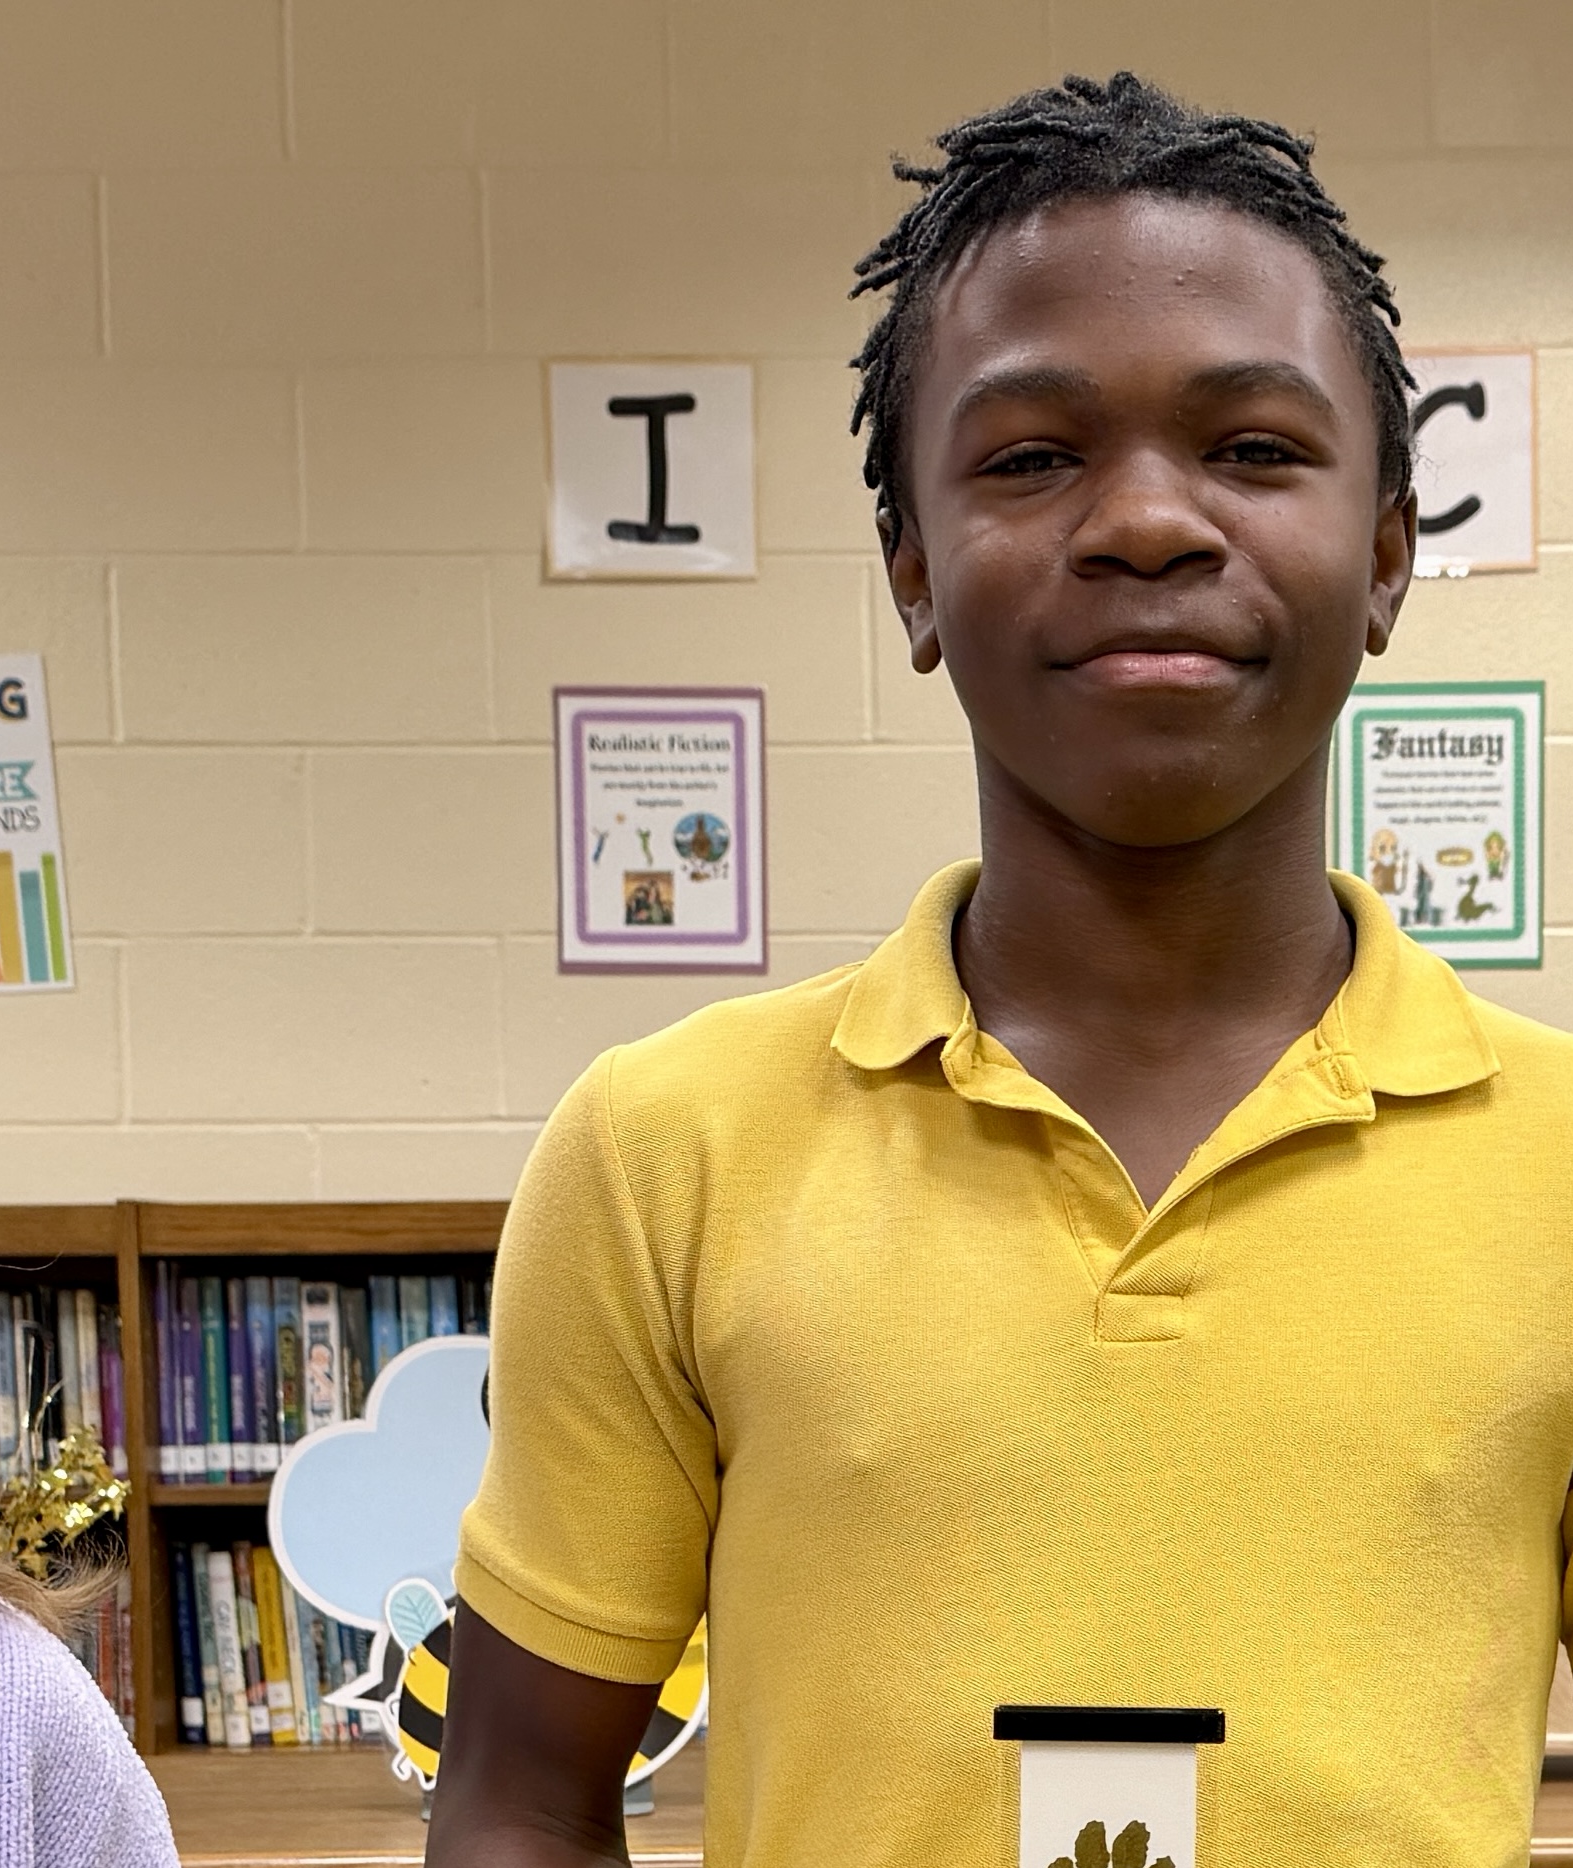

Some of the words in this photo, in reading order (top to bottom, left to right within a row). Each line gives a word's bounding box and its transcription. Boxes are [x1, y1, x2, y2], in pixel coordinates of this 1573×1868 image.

[607, 393, 703, 544] I
[1413, 381, 1488, 535] C
[588, 733, 663, 752] Realistic
[667, 733, 732, 752] Fiction
[1370, 727, 1504, 765] Fantasy
